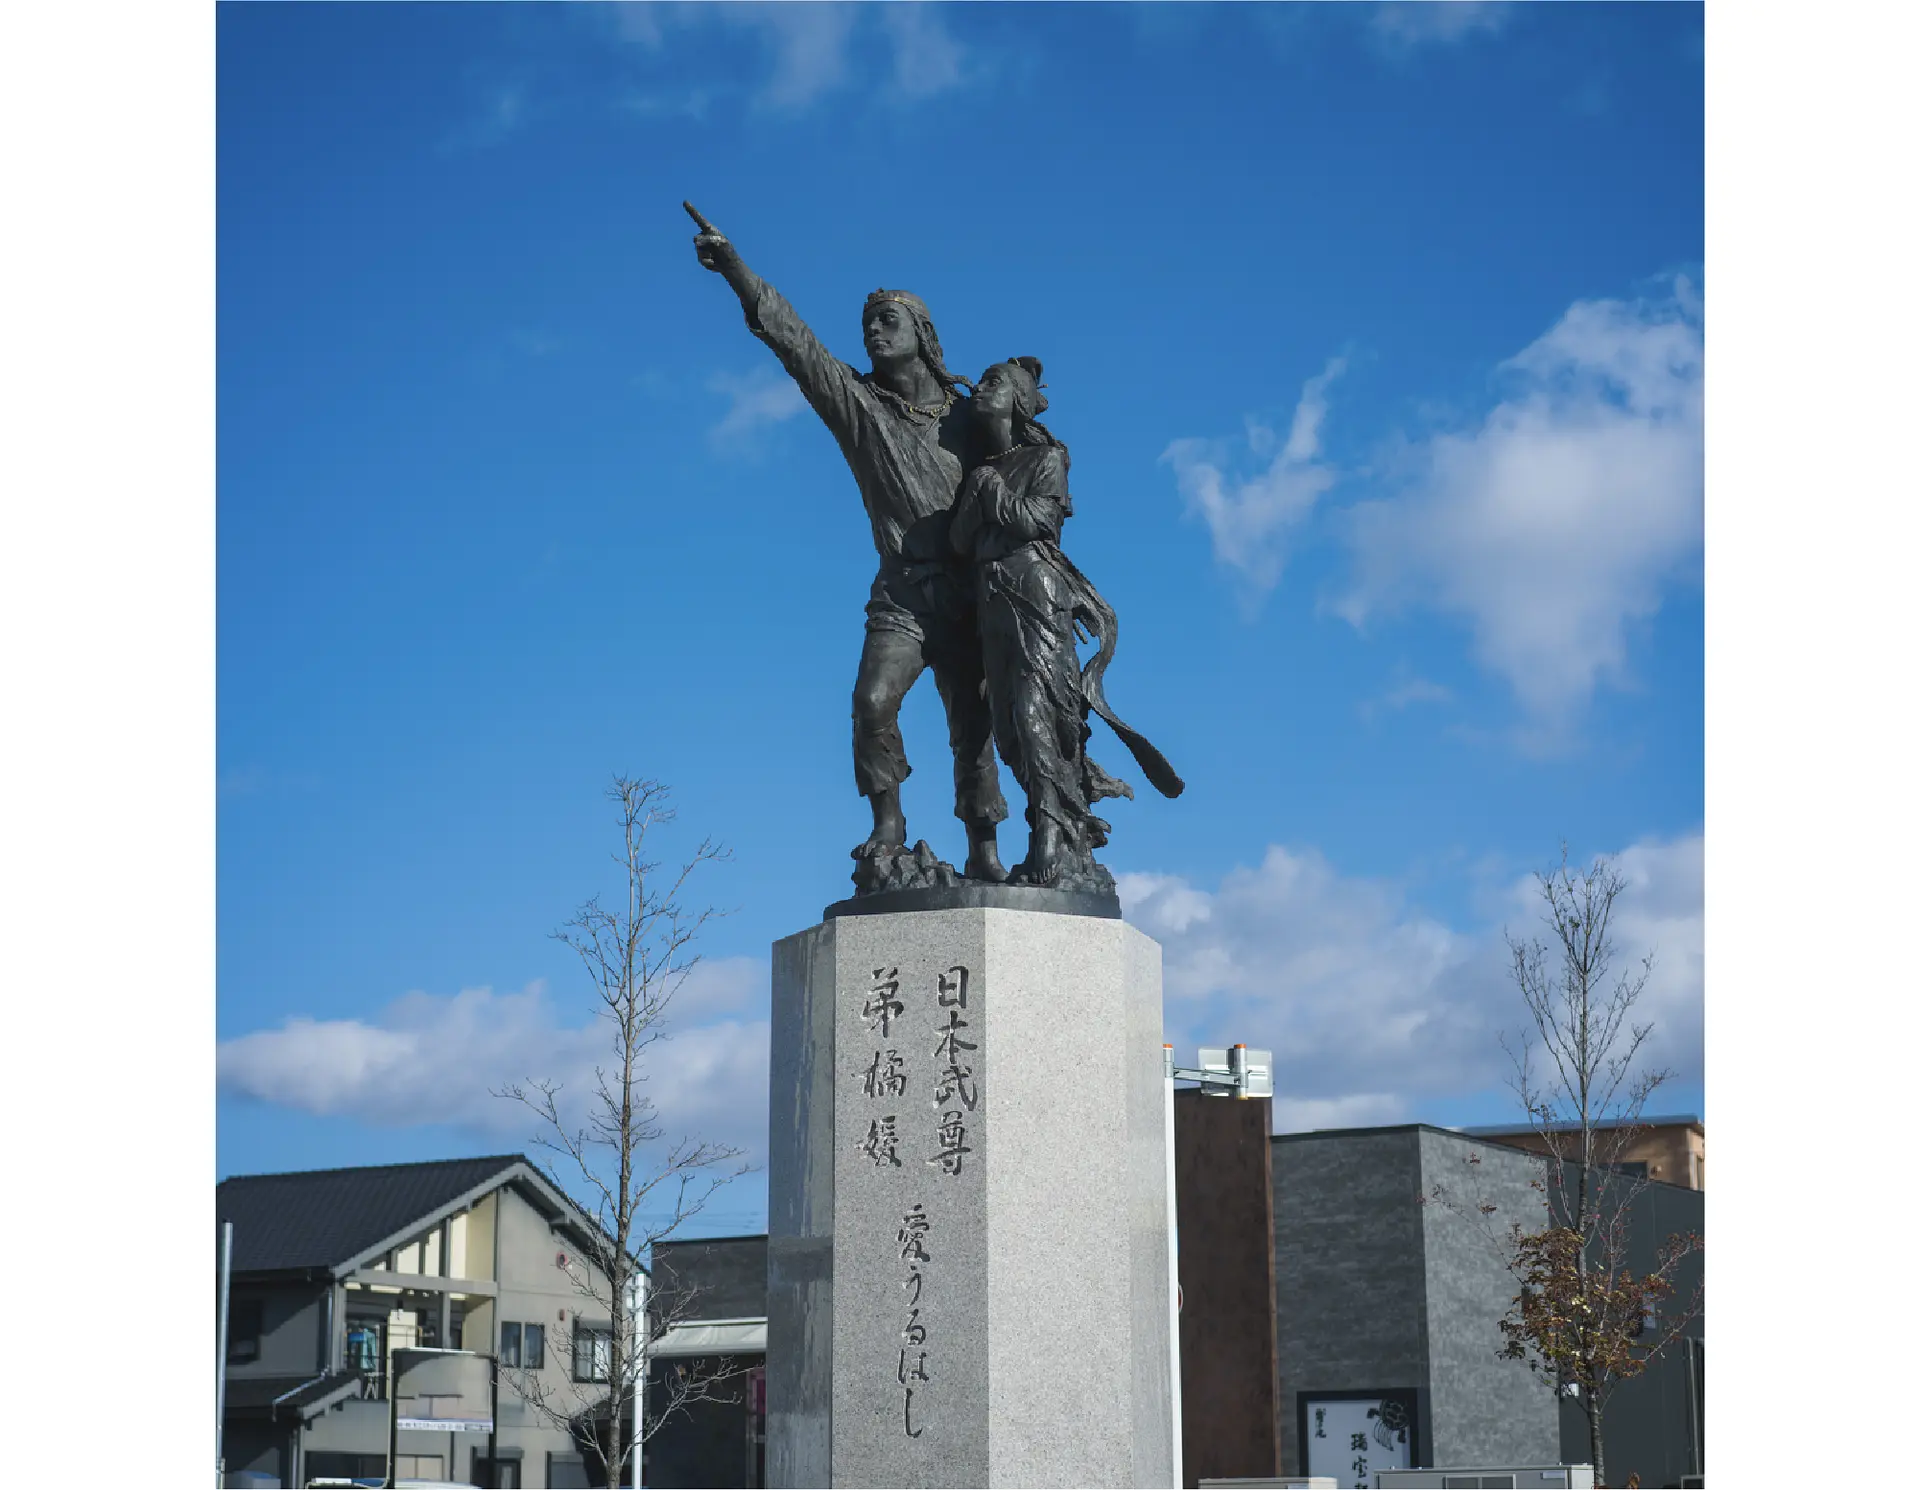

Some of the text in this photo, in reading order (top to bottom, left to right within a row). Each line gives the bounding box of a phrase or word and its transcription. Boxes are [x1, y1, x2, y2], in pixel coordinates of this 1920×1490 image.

[861, 967, 907, 1168] 弟橘媛
[929, 965, 978, 1176] 日本武尊
[898, 1203, 930, 1439] 愛うるはし
